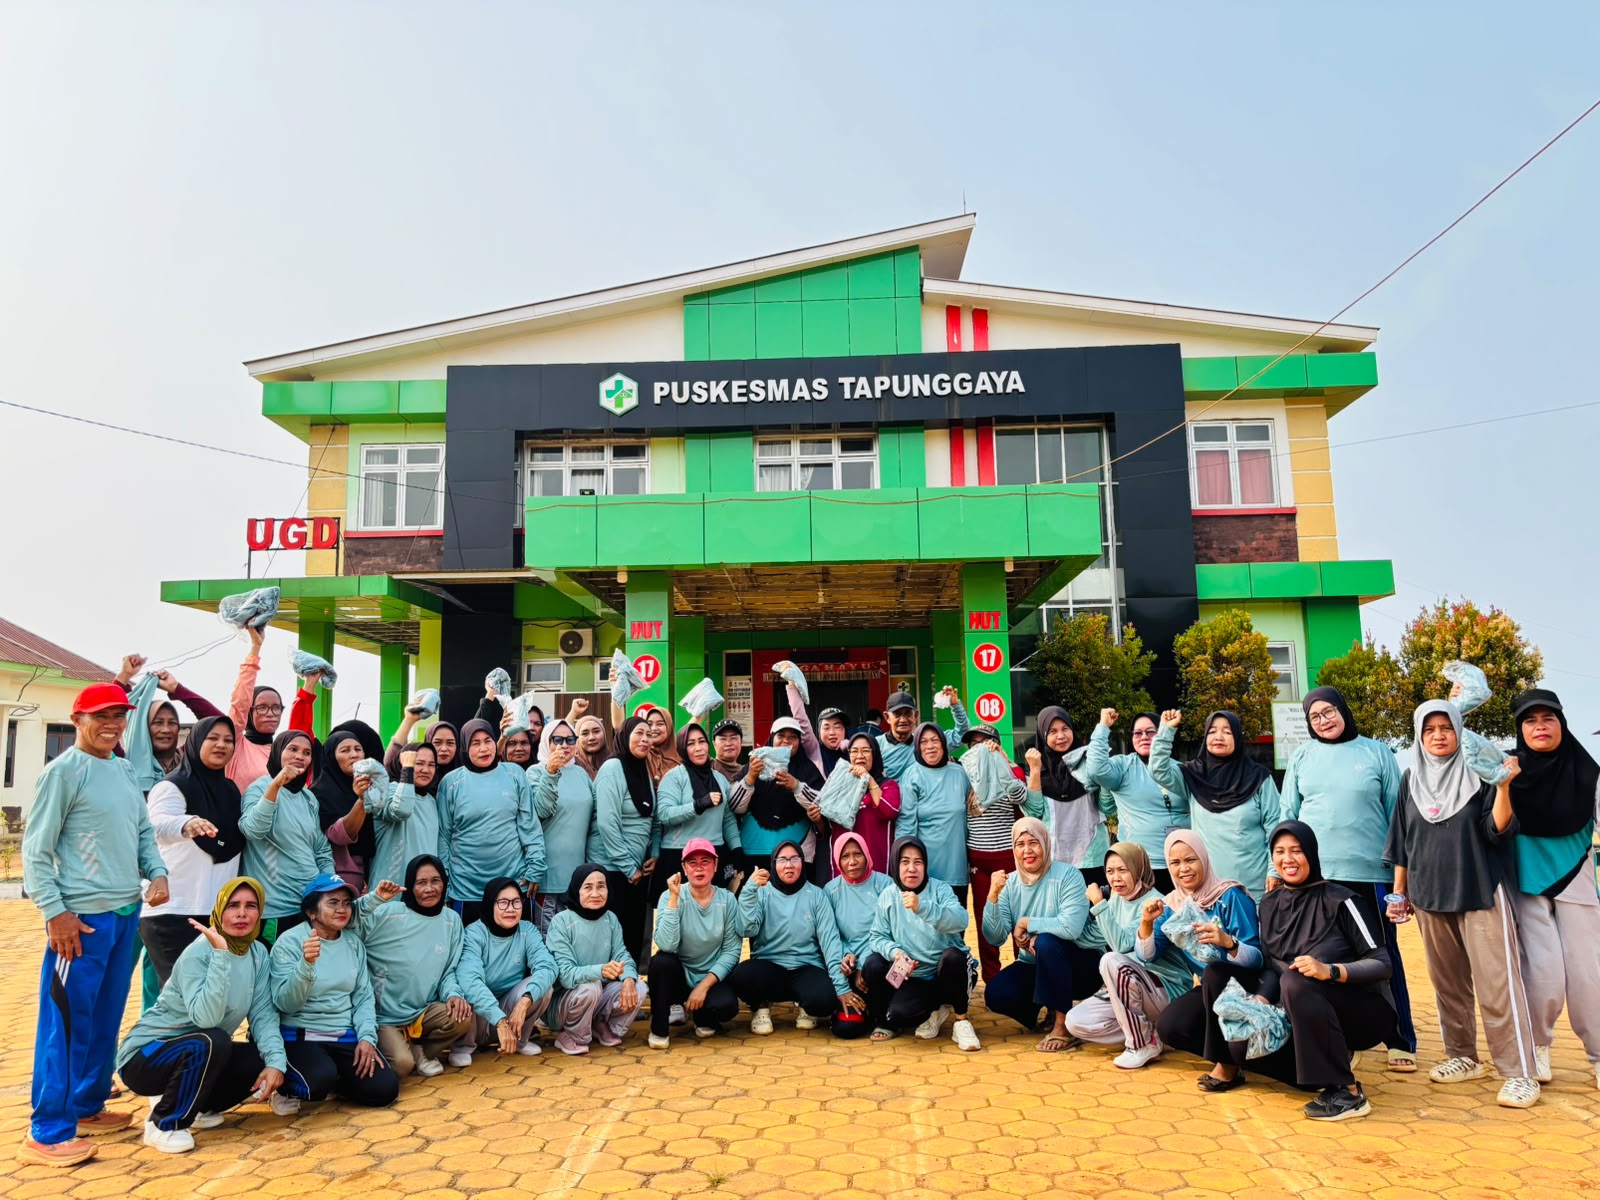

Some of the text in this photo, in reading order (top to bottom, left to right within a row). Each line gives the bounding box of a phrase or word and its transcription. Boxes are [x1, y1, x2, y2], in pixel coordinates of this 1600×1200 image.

[653, 370, 1026, 405] PUSKESMAS TAPUNGGAYA
[246, 517, 338, 551] UGD
[968, 611, 1001, 630] HUT
[630, 621, 663, 640] HUT
[979, 649, 997, 668] 17
[637, 660, 655, 678] 17
[979, 698, 1000, 717] 08
